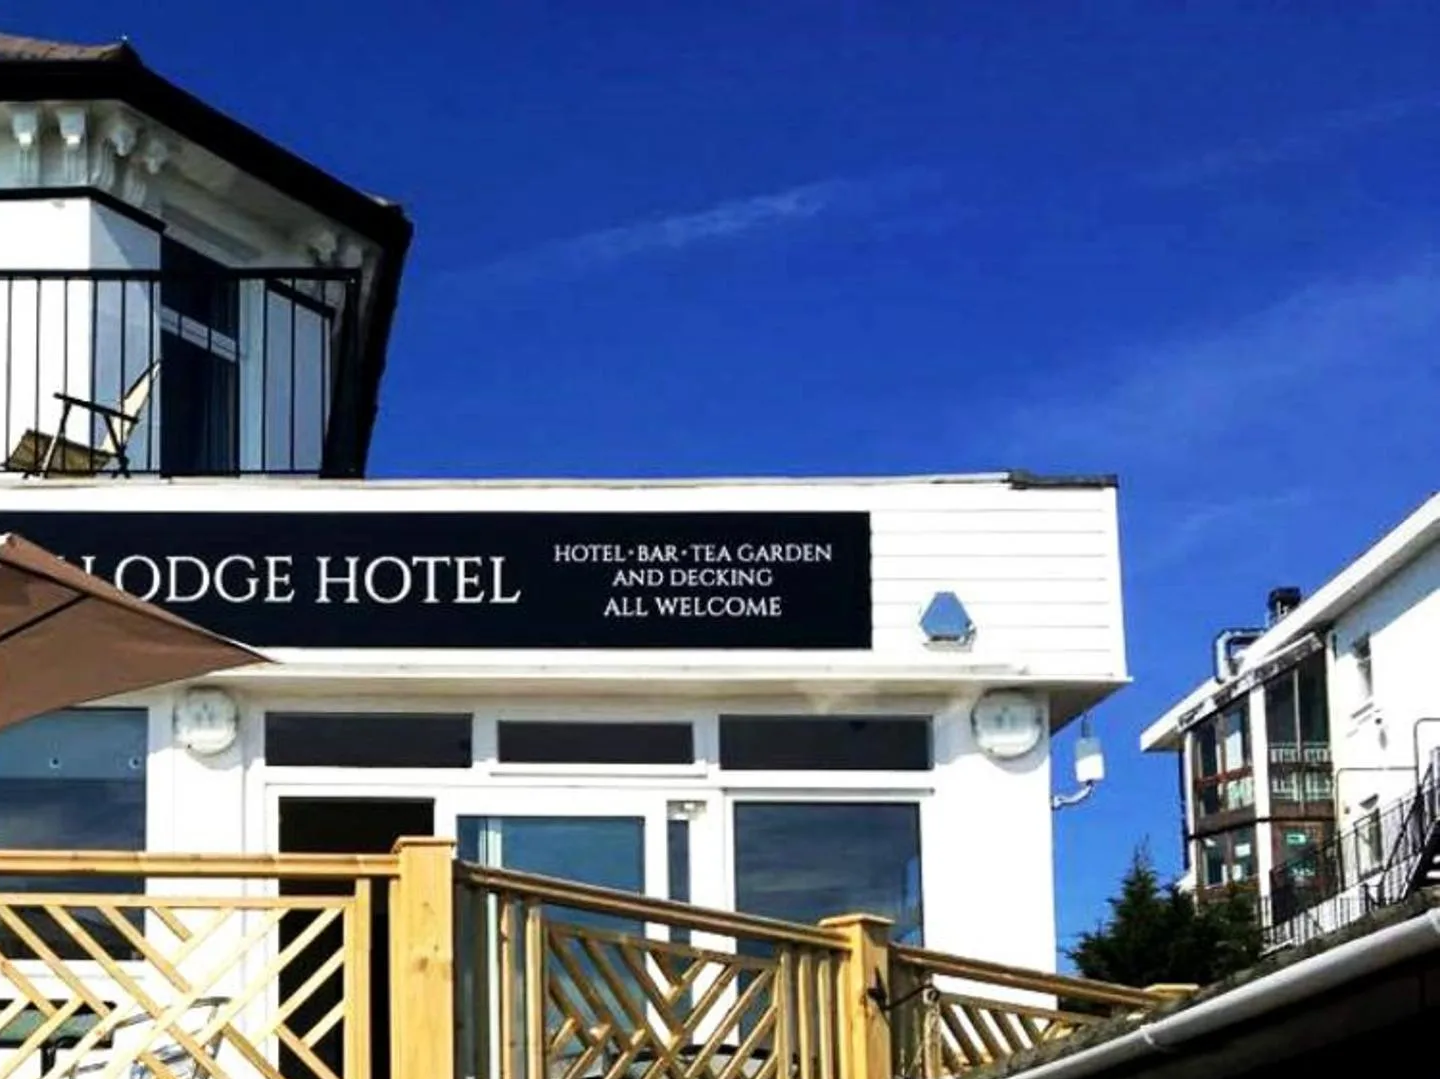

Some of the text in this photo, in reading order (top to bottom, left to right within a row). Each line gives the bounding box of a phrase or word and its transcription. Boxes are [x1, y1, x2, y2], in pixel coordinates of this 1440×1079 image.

[737, 543, 832, 562] GARDEN
[317, 556, 520, 603] HOTEL
[612, 568, 773, 587] AND DECKING
[603, 596, 782, 617] ALL WELCOME
